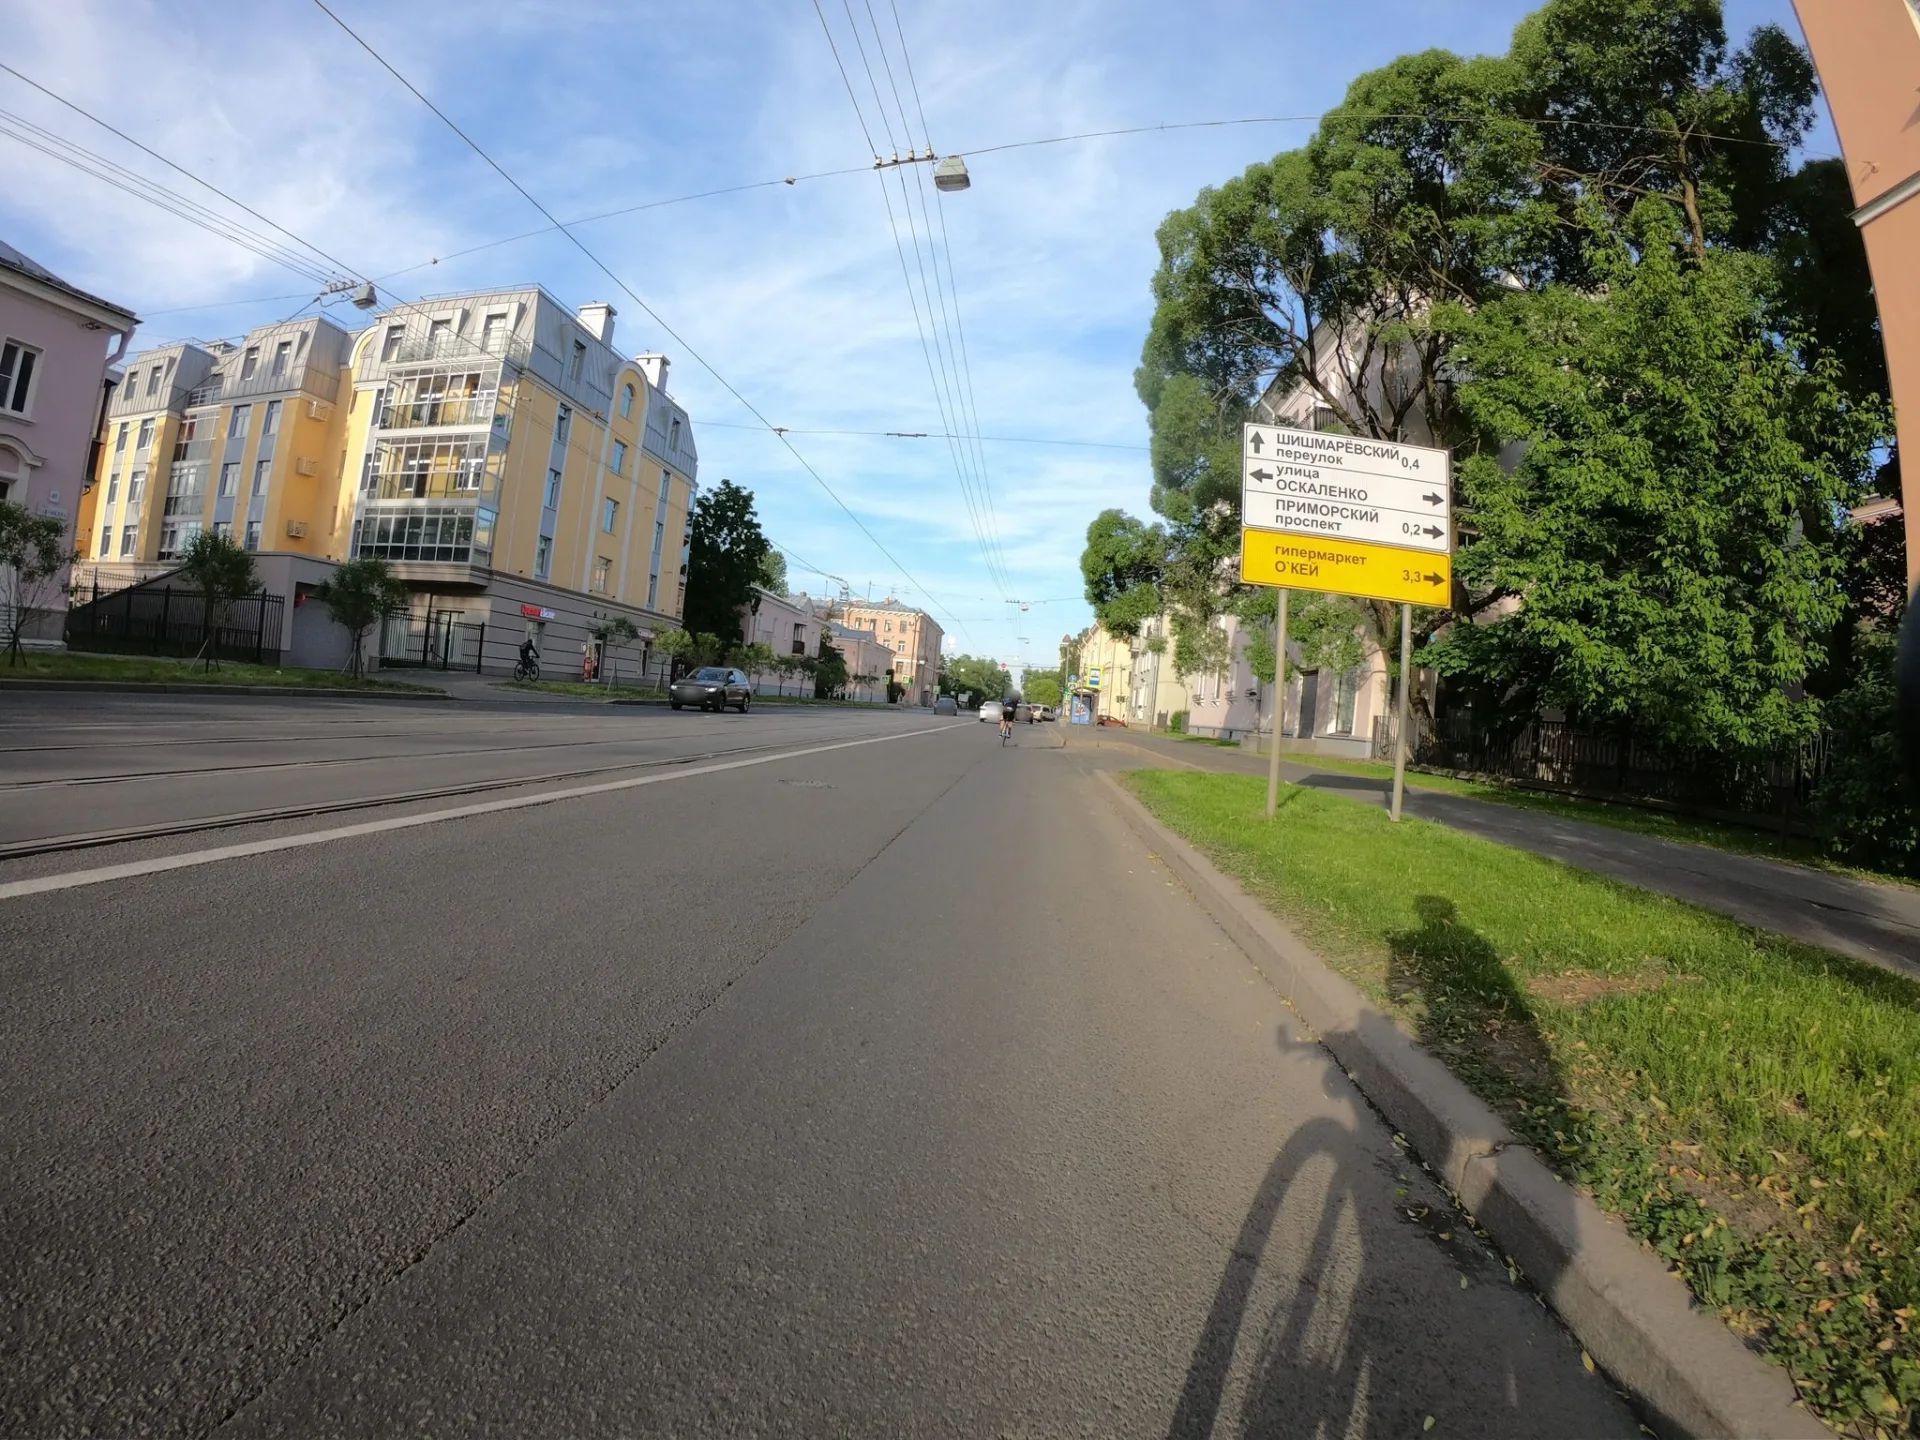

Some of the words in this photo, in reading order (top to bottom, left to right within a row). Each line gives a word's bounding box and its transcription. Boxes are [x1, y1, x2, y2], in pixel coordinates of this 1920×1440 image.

[1277, 433, 1399, 460] ШИШМАРЁВСКИЙ
[1276, 447, 1343, 465] переулок
[1401, 457, 1420, 470] 0,4
[1276, 465, 1320, 480] улица
[1276, 478, 1368, 501] ОСКАЛЕНКО
[1276, 499, 1379, 523] ПРИМОРСКИЙ
[1275, 514, 1342, 531] проспект
[1402, 523, 1421, 537] 0,2
[1275, 545, 1367, 565] гипермаркет
[1403, 570, 1421, 584] 3,3
